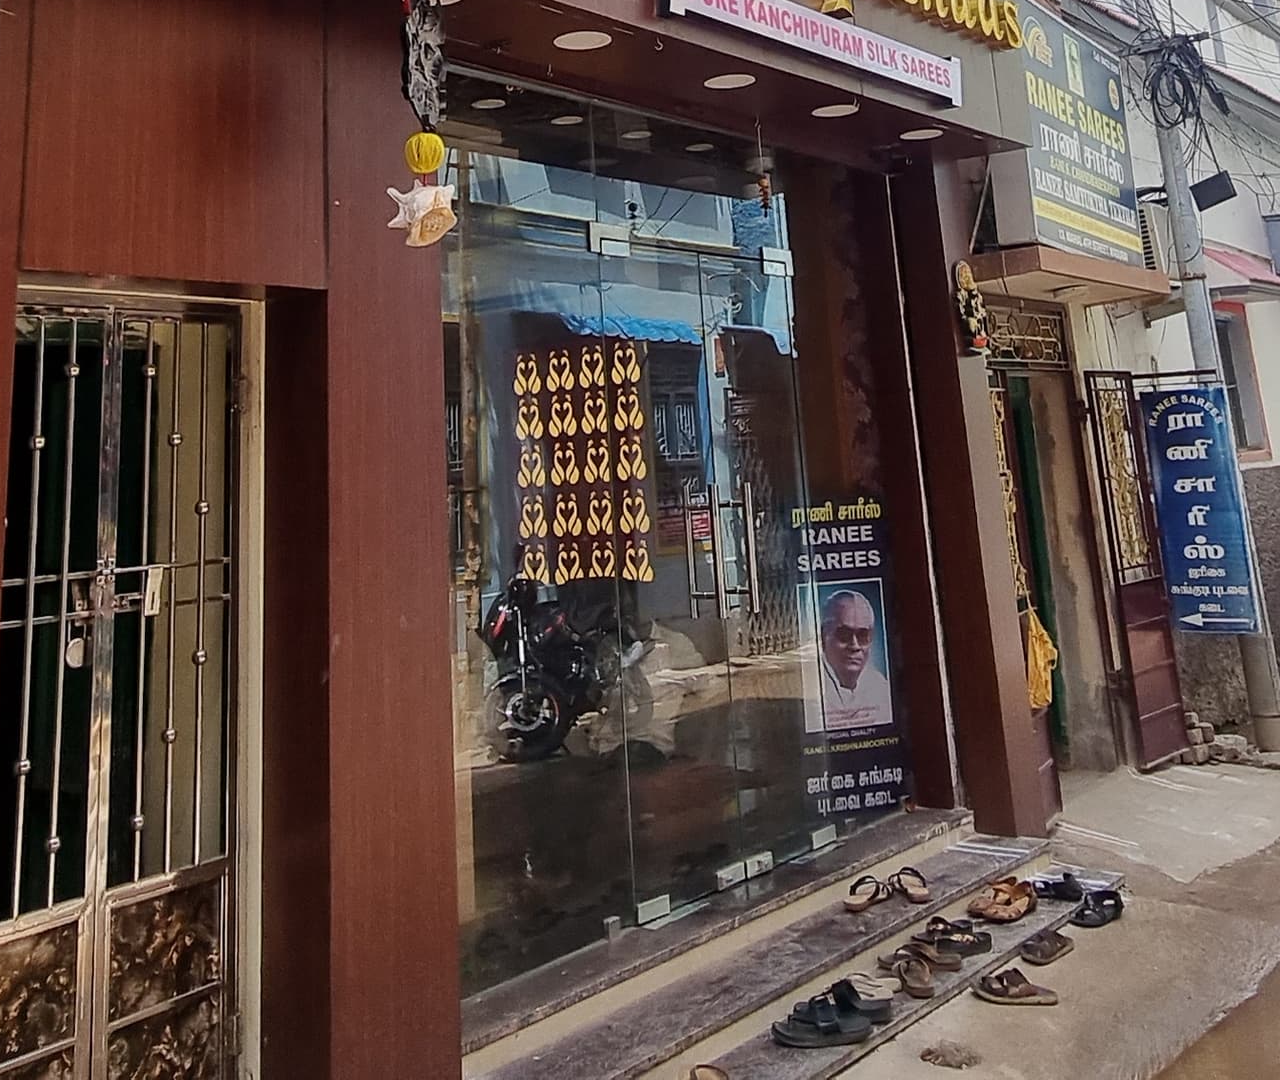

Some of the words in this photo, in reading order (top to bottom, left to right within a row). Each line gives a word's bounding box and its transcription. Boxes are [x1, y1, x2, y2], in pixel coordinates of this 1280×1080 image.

[866, 38, 899, 71] SILK
[901, 49, 952, 89] SAREES
[1025, 70, 1076, 127] RANEE
[1077, 100, 1126, 154] SAREES
[1148, 395, 1179, 427] RANEE
[801, 524, 874, 546] RANEE
[797, 549, 881, 572] SAREES
